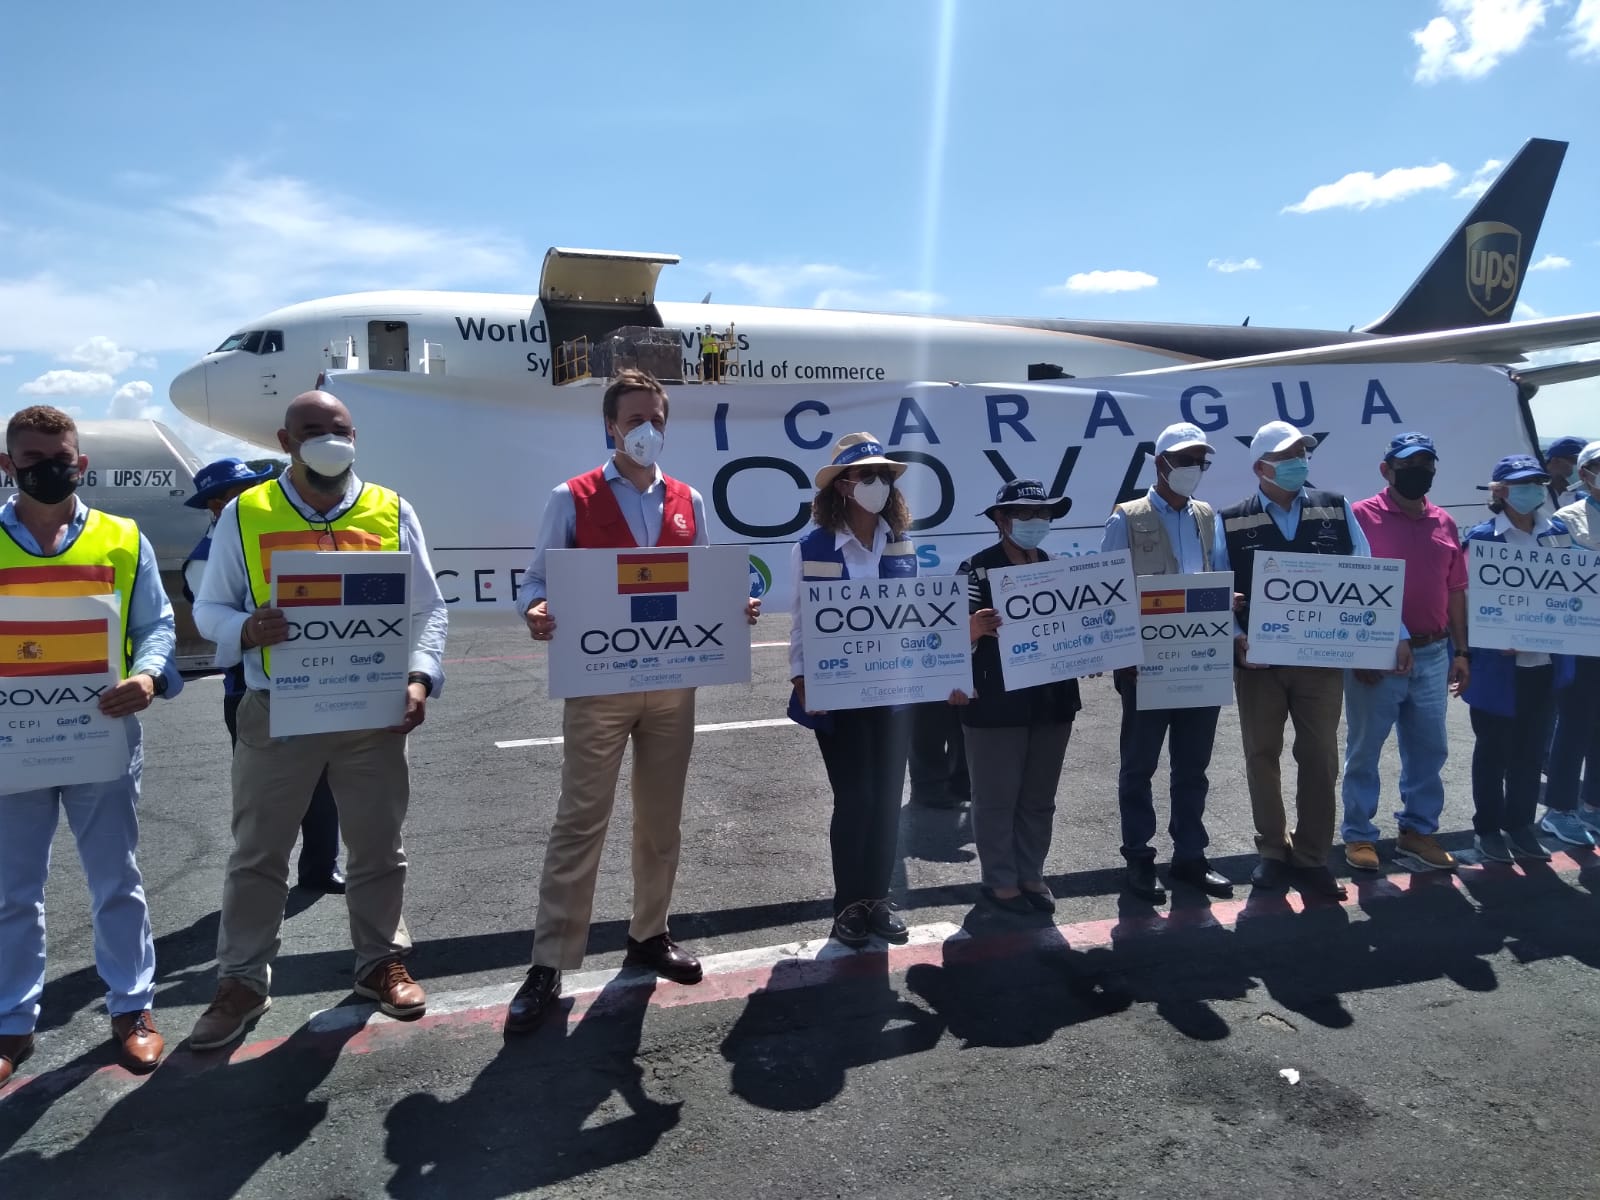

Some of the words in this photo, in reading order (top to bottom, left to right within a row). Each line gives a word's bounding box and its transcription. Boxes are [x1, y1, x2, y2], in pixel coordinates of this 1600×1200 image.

[1470, 249, 1516, 301] ups
[454, 316, 548, 343] World
[722, 360, 763, 377] orld
[771, 360, 788, 379] of
[795, 365, 885, 380] commerce
[605, 379, 1403, 451] ICARAGUA
[1476, 545, 1600, 567] NICARAGUA
[1479, 564, 1598, 594] COVAX
[809, 581, 961, 602] NICARAGUA
[1263, 577, 1394, 608] COVAX
[1005, 578, 1128, 620] COVAX
[1498, 594, 1529, 607] CEPI
[1545, 597, 1568, 609] Gavi
[815, 601, 958, 634] COVAX
[1286, 609, 1321, 623] CEPI
[1339, 611, 1362, 623] Gavi
[1479, 606, 1503, 616] OPS
[1081, 614, 1103, 627] Gavi
[1515, 613, 1543, 623] unicef
[1032, 621, 1066, 638] CEPI
[1141, 621, 1229, 641] COVAX
[1261, 622, 1290, 633] OPS
[1304, 628, 1337, 640] unicef
[580, 622, 724, 655] COVAX
[901, 637, 926, 649] Gavi
[1053, 636, 1082, 652] unicef
[843, 640, 881, 654] CEPI
[1012, 641, 1039, 655] OPS
[301, 656, 334, 667] CEPI
[350, 654, 372, 664] Gavi
[1157, 651, 1180, 660] CEPI
[586, 662, 609, 672] CEPI
[818, 658, 849, 670] OPS
[865, 657, 899, 672] unicef
[276, 675, 310, 685] PAHO
[8, 720, 41, 729] CEPI
[57, 716, 79, 725] Gavi
[26, 734, 56, 744] unicef
